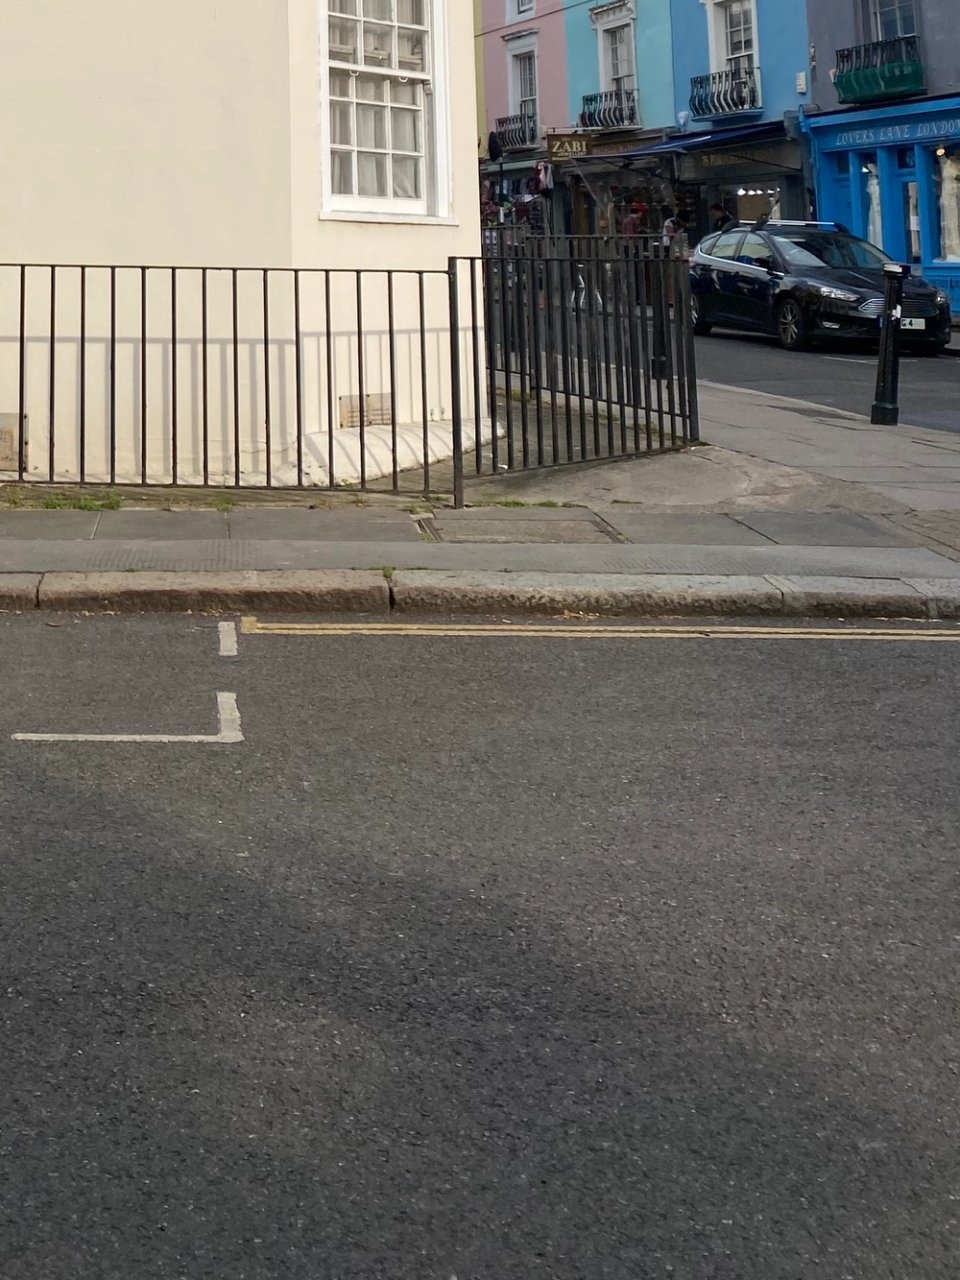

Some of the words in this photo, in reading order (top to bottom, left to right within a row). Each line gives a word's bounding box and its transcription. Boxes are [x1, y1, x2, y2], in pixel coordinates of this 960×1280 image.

[836, 129, 875, 145] LOVERS
[880, 124, 911, 140] LANE
[552, 141, 587, 152] ZABI
